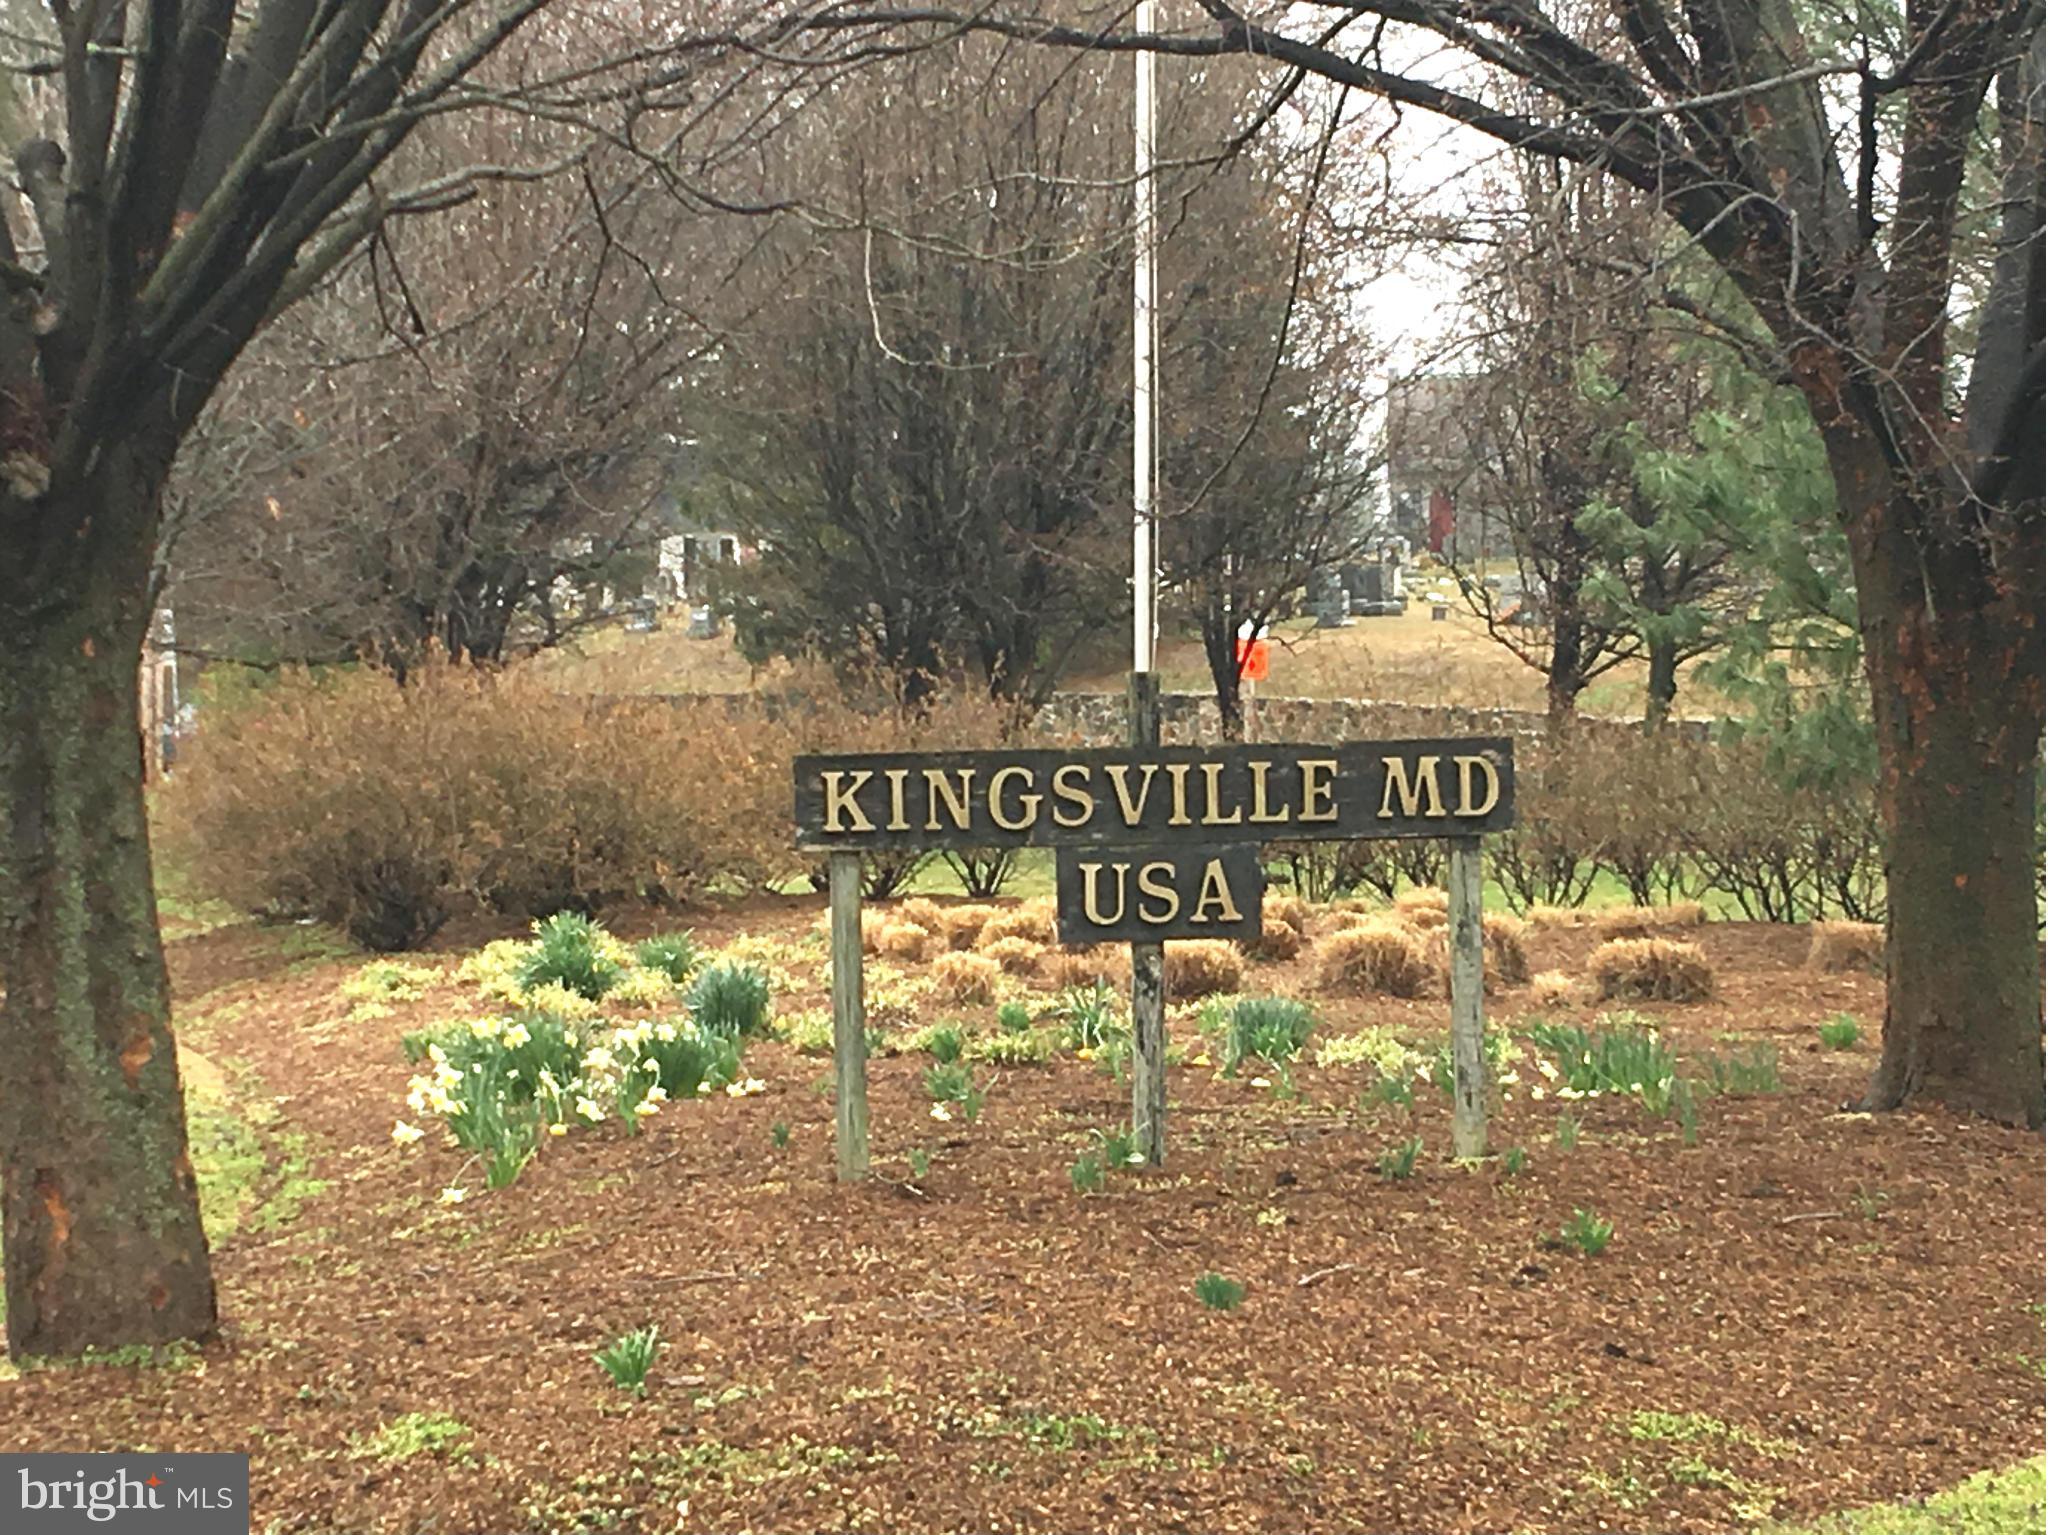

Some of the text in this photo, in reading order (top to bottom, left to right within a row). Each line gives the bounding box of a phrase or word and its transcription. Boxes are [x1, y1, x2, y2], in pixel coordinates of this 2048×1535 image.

[820, 755, 1500, 832] KINGSVILLE MD
[1079, 857, 1244, 926] USA
